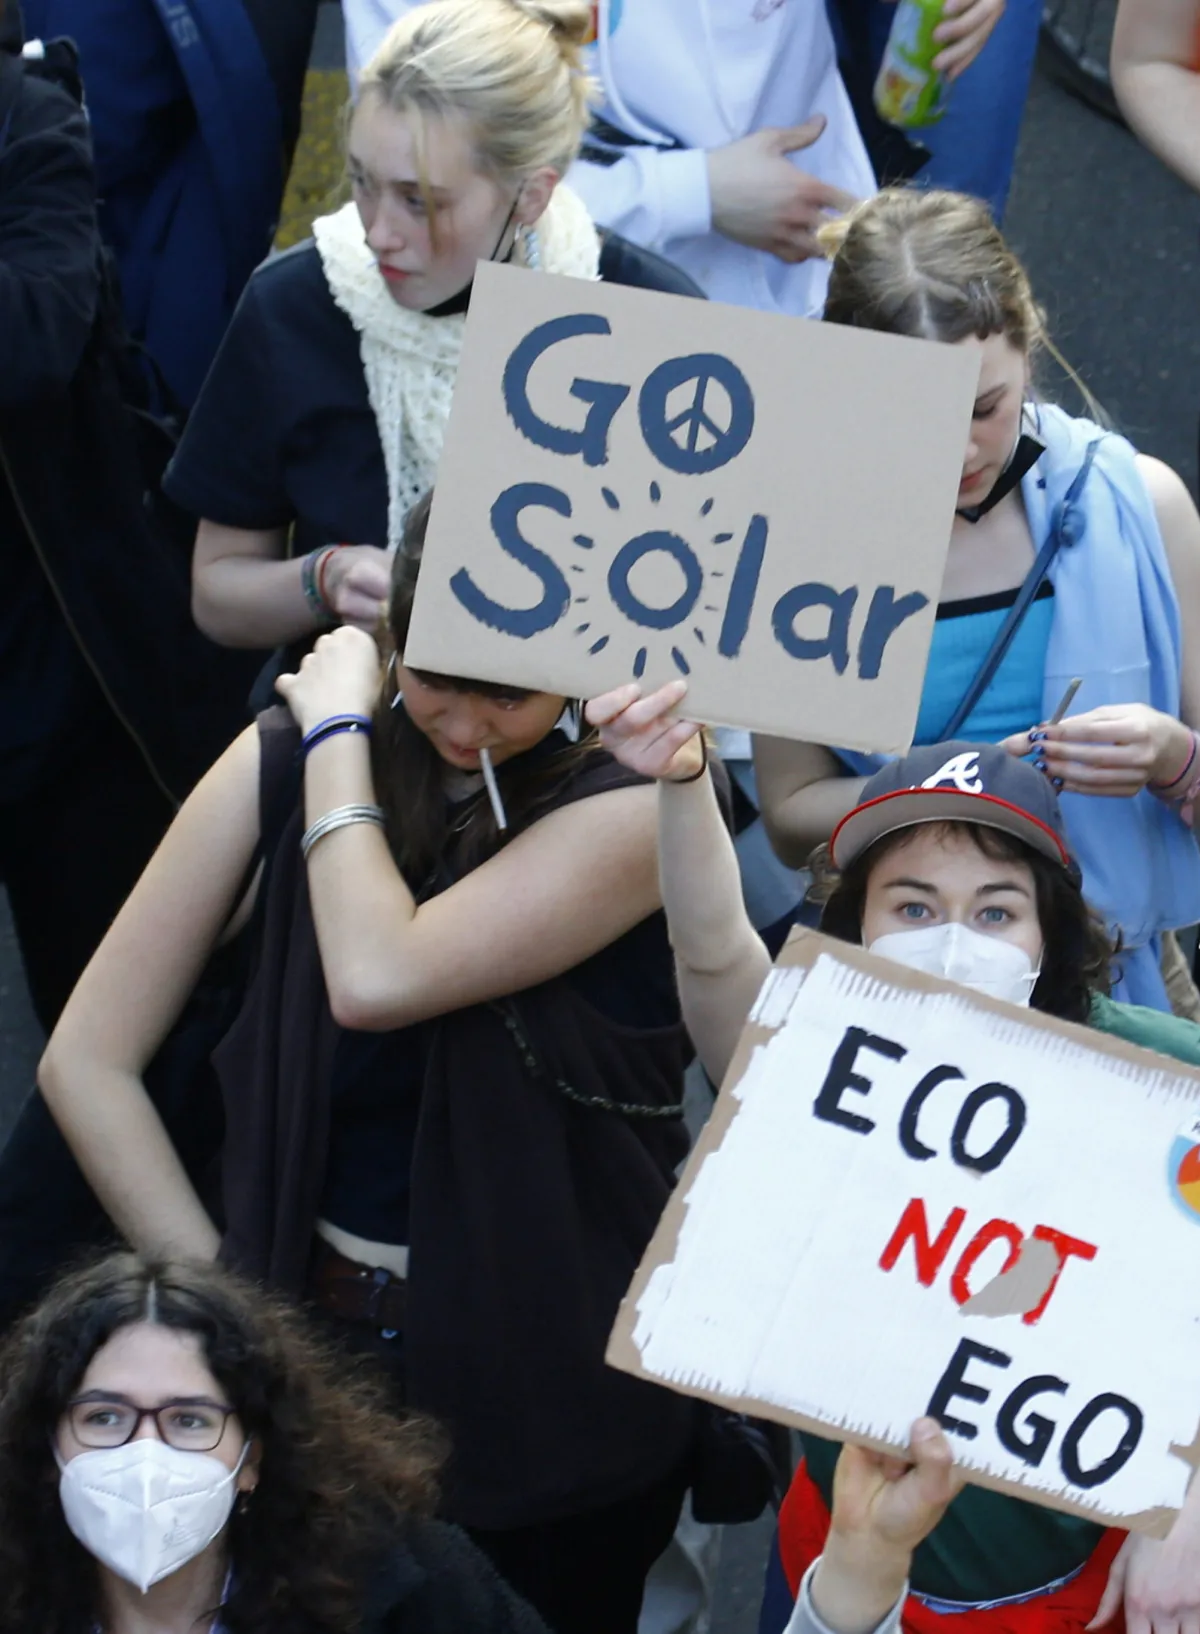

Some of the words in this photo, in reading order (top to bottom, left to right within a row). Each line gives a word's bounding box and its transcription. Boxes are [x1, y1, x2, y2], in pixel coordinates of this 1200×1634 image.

[812, 1025, 1028, 1174] ECO
[877, 1197, 1099, 1326] NOT
[923, 1336, 1145, 1490] EGO
